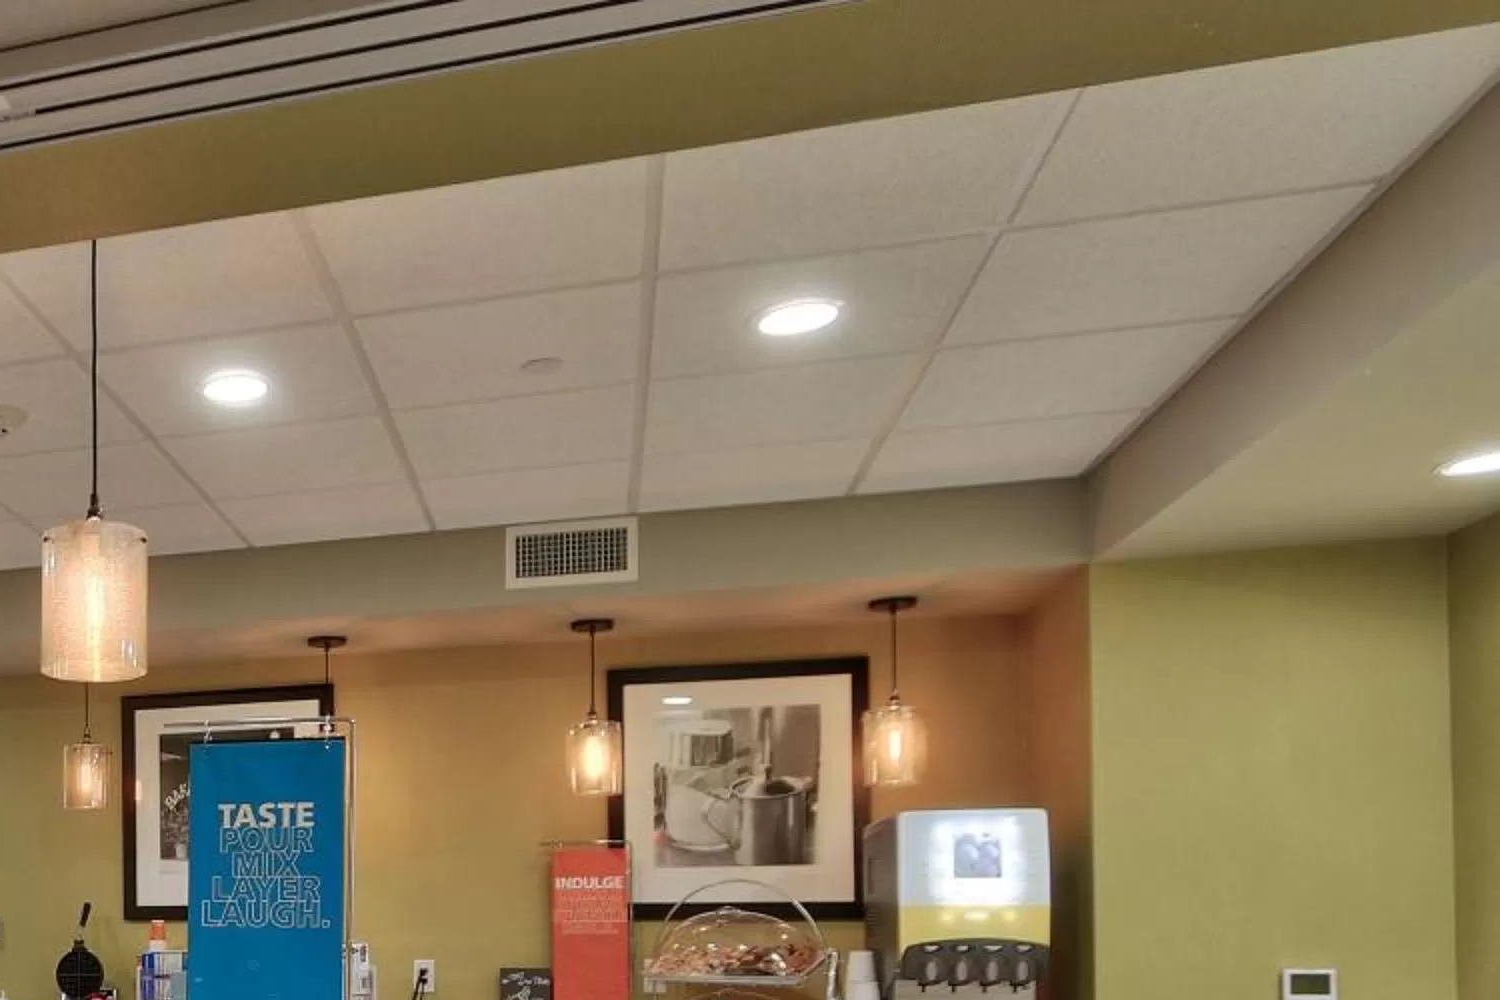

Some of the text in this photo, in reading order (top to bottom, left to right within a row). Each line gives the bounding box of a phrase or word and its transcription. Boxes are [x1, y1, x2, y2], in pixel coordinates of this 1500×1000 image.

[217, 801, 315, 829] TASTE
[219, 826, 315, 853] POUR
[231, 851, 301, 878] MIX
[211, 875, 321, 902] LAYER
[555, 876, 625, 889] INDULGE
[201, 899, 332, 928] LAUGH.
